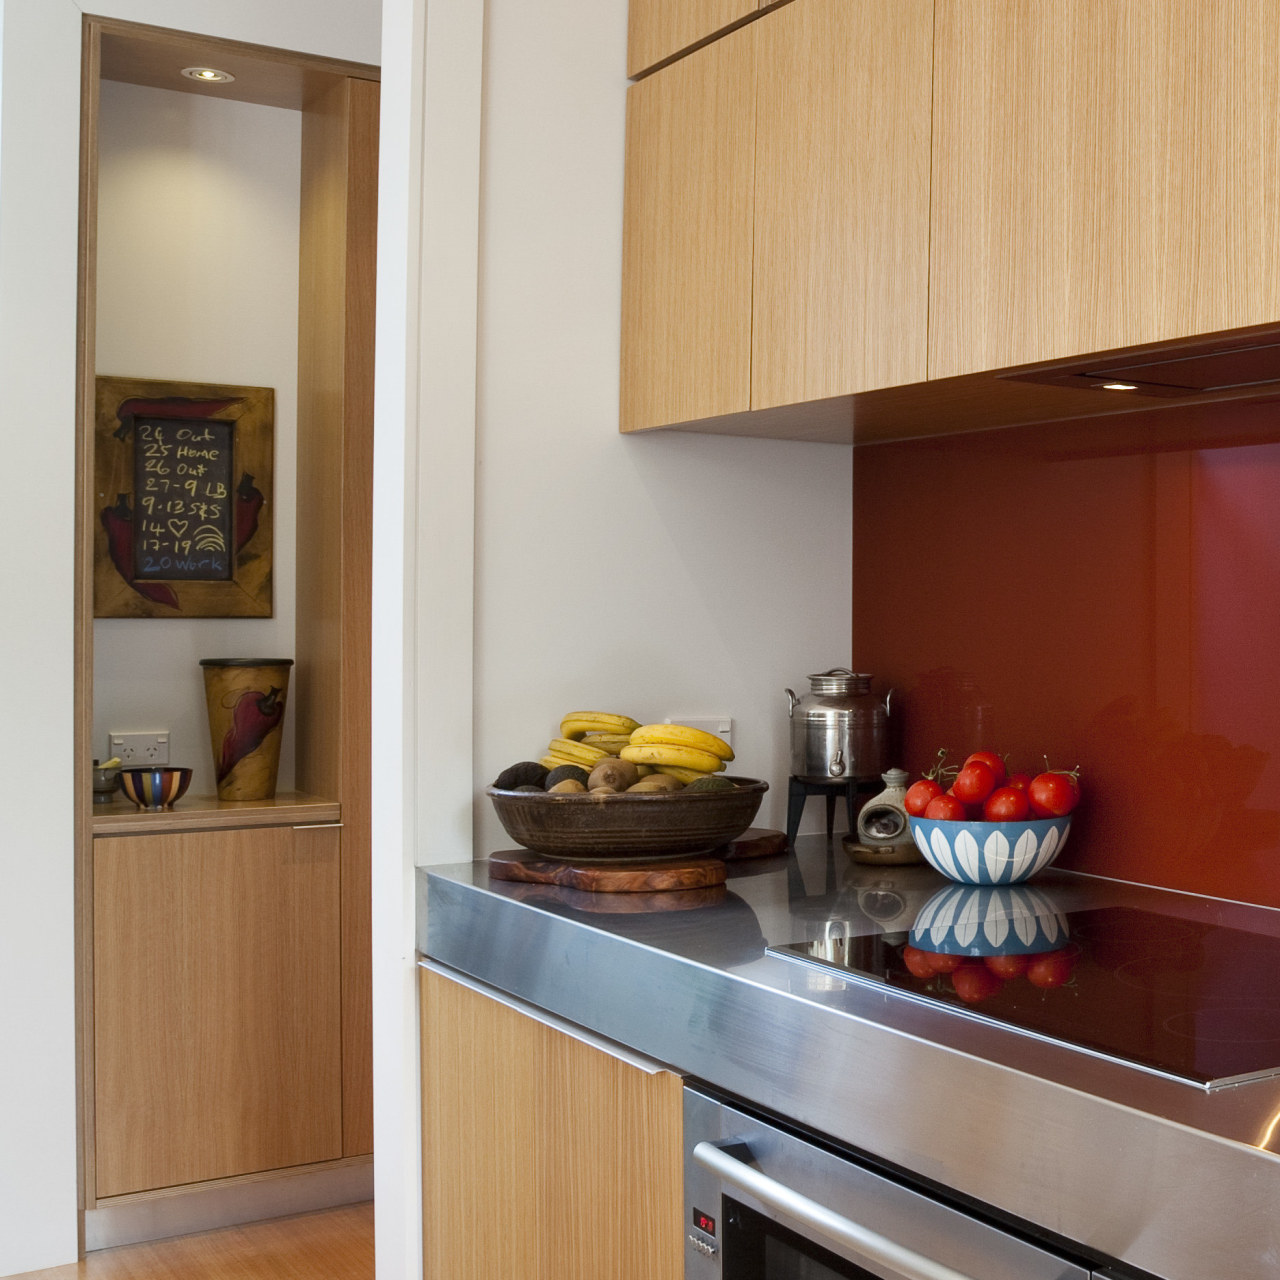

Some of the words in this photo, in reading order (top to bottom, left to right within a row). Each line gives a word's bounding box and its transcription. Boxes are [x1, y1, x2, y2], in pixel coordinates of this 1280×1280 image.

[144, 444, 172, 457] 25
[177, 446, 219, 461] Home
[145, 459, 170, 475] 26
[142, 520, 166, 537] 14
[143, 556, 171, 572] 20
